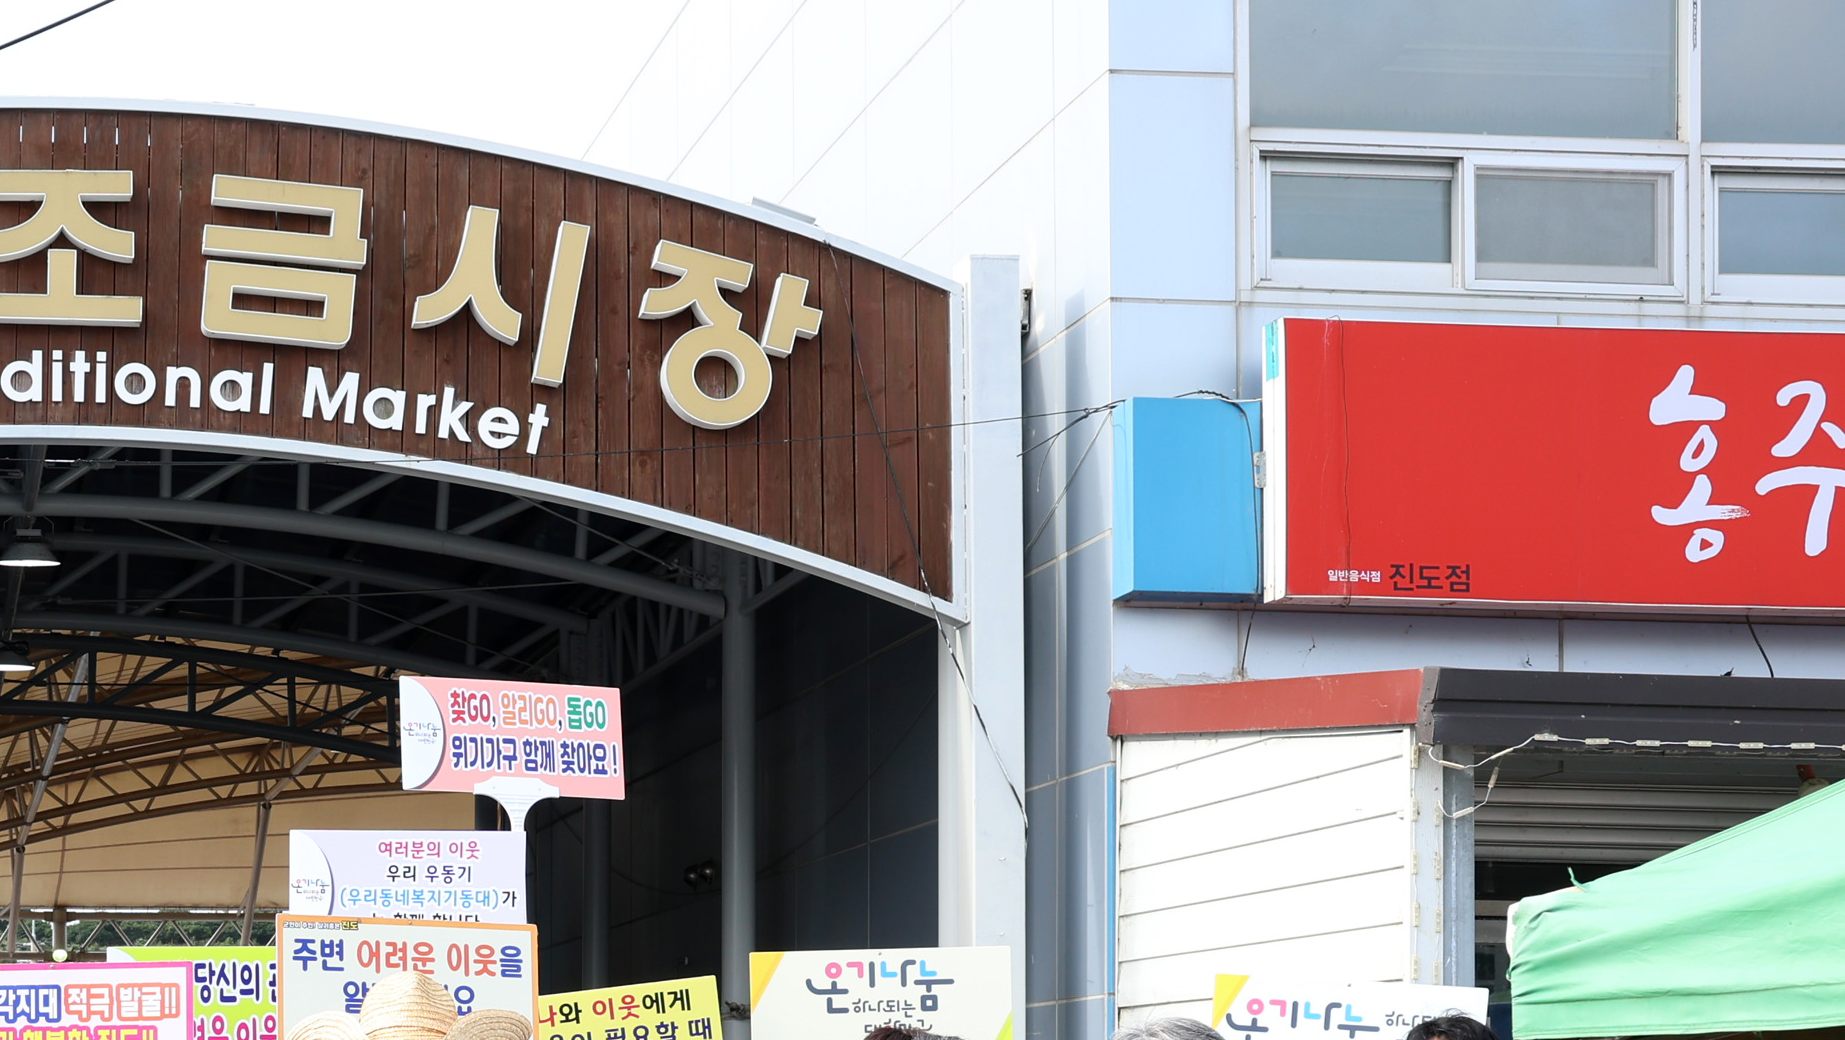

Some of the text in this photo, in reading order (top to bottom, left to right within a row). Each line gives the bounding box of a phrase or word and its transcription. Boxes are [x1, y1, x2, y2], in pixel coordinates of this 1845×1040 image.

[302, 365, 551, 454] Market
[1327, 562, 1471, 593] 일반음식점 진도점
[452, 736, 518, 770] 위기가구
[523, 738, 556, 773] 함께
[378, 840, 481, 860] 여러분의 이웃
[386, 864, 472, 884] 우리 우동기
[292, 938, 524, 979] 주변 어려운 이웃을
[193, 961, 260, 1004] 당신의
[806, 959, 955, 1014] 온기나눔
[64, 983, 113, 1022] 적극
[116, 983, 180, 1022] 발굴!!
[591, 988, 692, 1021] 이웃에게
[852, 998, 916, 1018] 하나되는
[688, 1017, 714, 1040] 때
